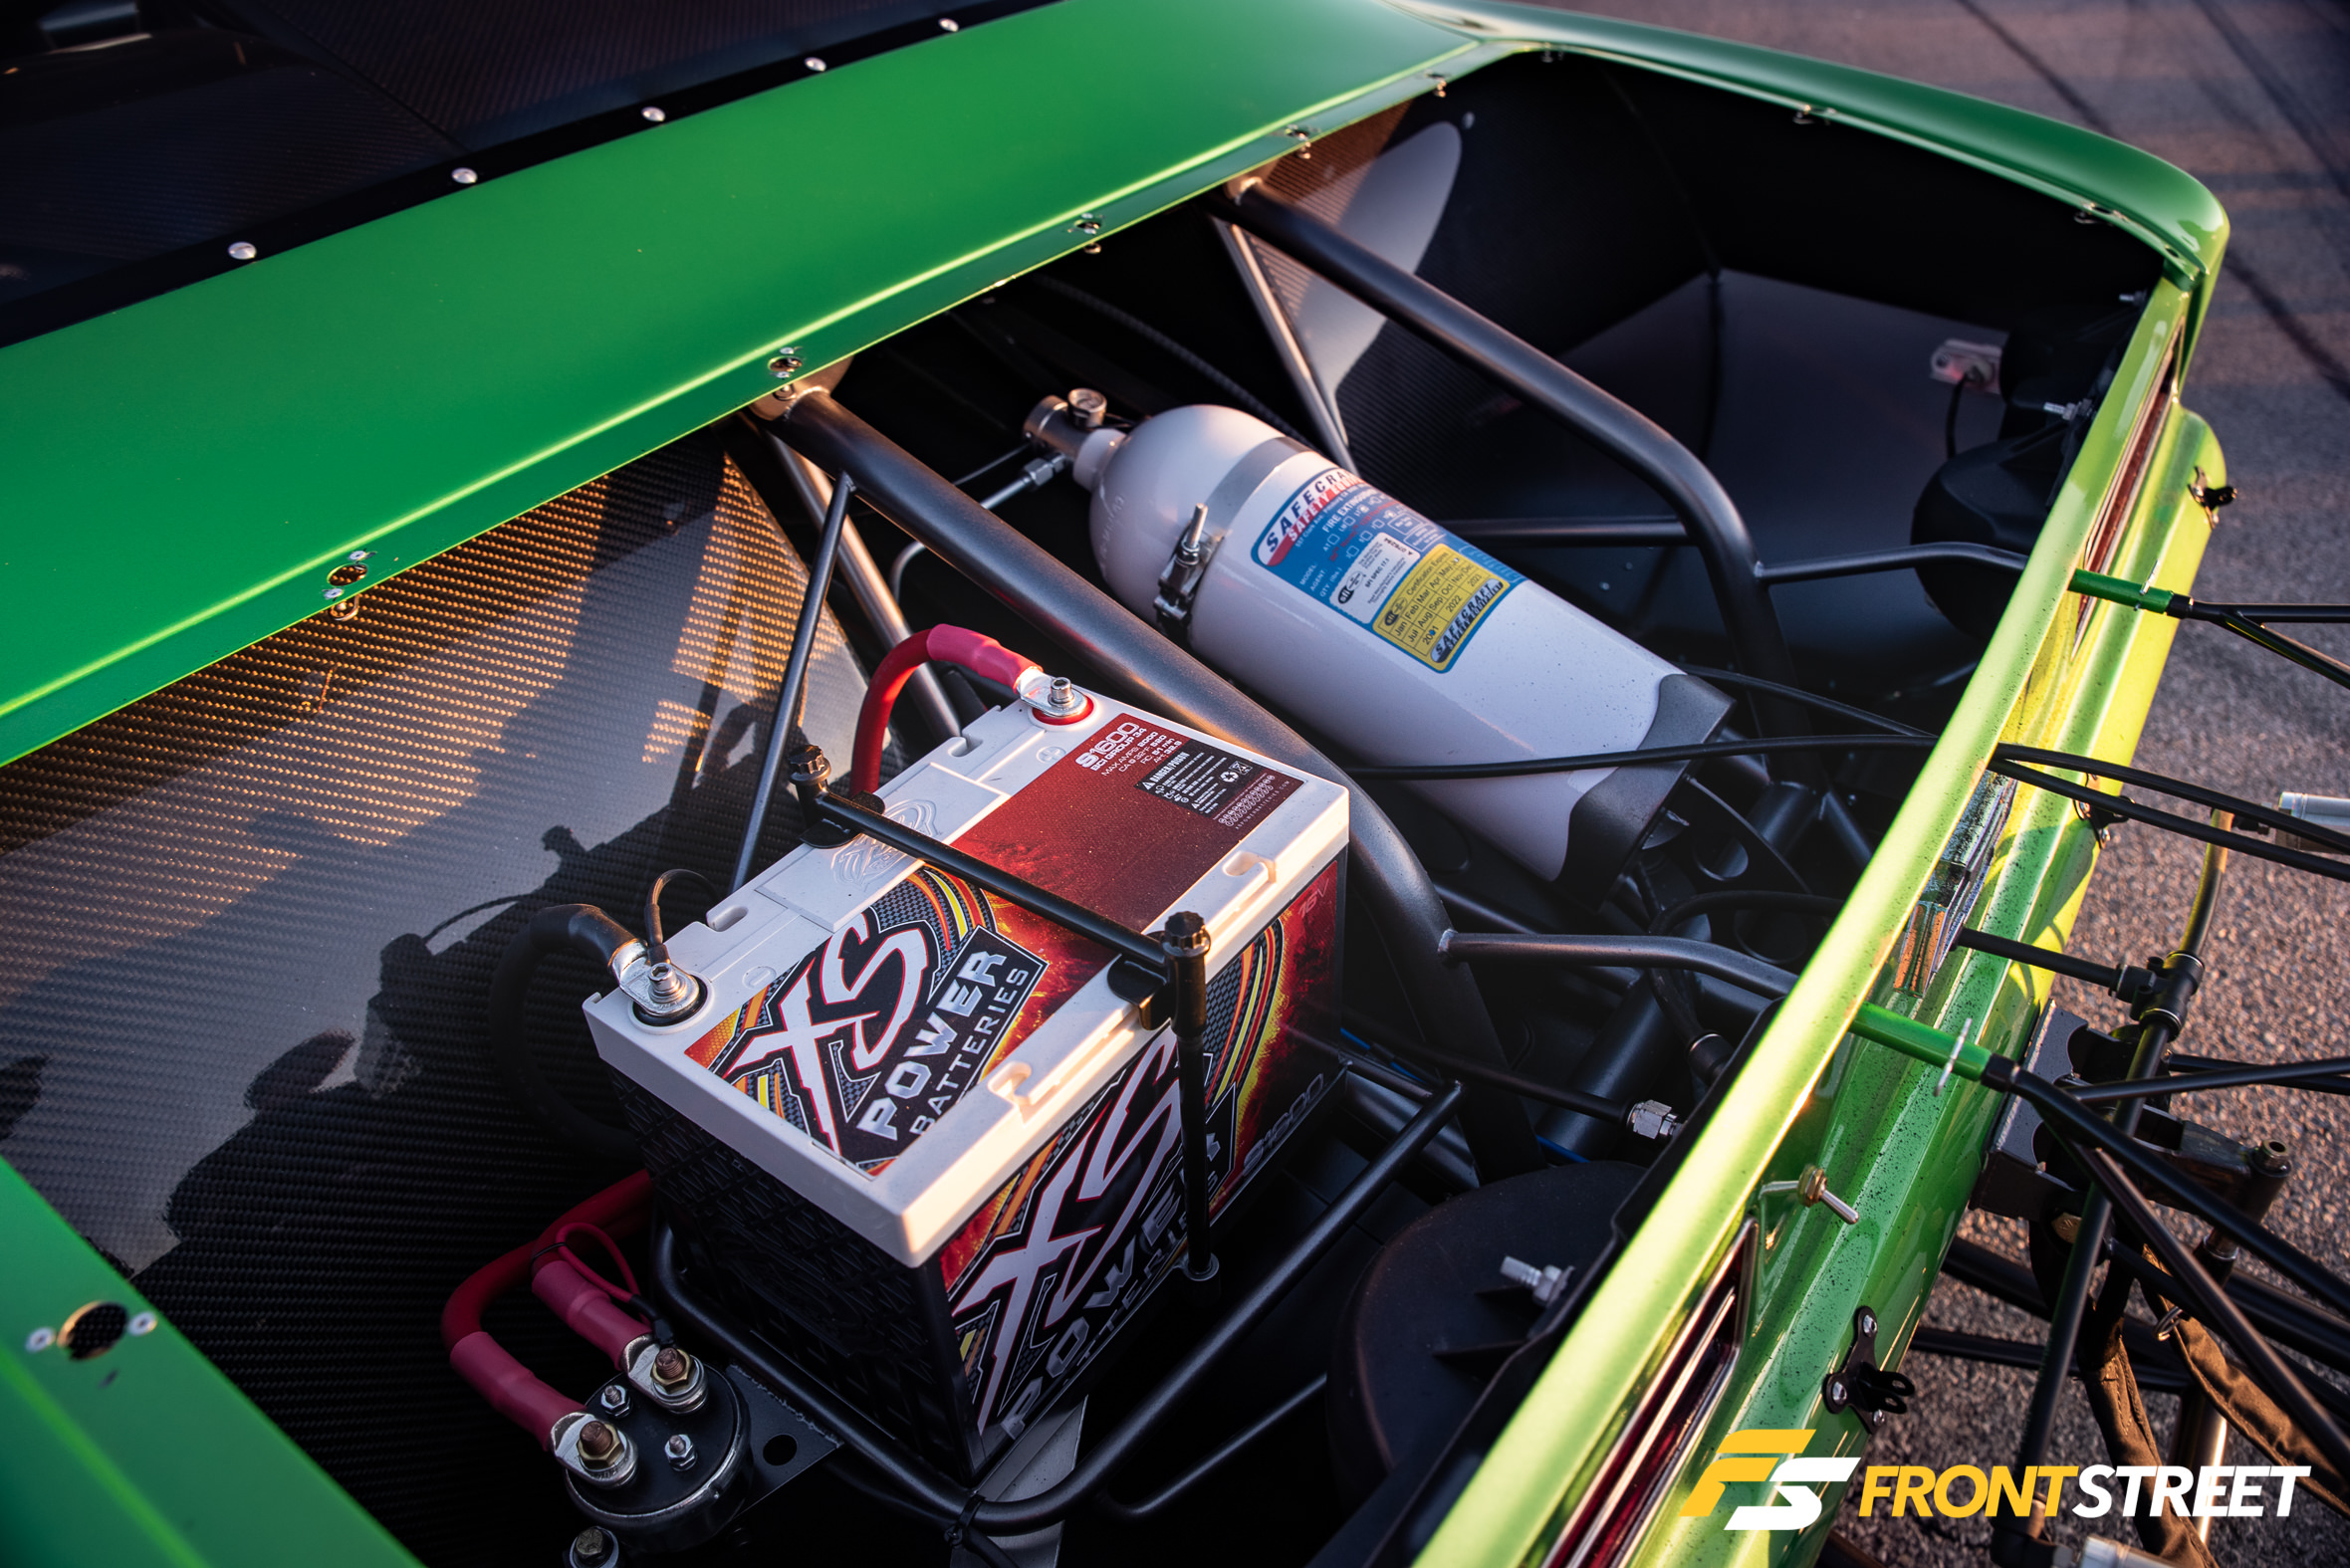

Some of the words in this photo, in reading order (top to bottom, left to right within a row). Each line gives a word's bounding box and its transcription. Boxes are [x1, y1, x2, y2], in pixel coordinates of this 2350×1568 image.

[1288, 488, 1332, 543] SAFETY
[1322, 515, 1340, 533] FIRE
[1394, 621, 1408, 636] Jan
[1404, 604, 1420, 620] Feb
[1416, 589, 1431, 603] Mar
[1429, 576, 1442, 589] Apr
[1439, 564, 1454, 576] May
[1406, 565, 1434, 595] Certification
[1408, 630, 1419, 643] Jul
[1418, 611, 1434, 628] Aug
[1429, 597, 1444, 611] Sep
[1441, 583, 1455, 595] Oct
[1451, 571, 1465, 584] Nov
[1422, 625, 1439, 646] 201
[1445, 594, 1463, 613] 2022
[1467, 573, 1483, 587] 2023
[1435, 582, 1493, 656] SAFECRAFT
[1075, 722, 1140, 769] S1600
[1101, 762, 1120, 777] MAX
[1104, 737, 1135, 761] GROUP
[1132, 728, 1147, 738] 34
[1118, 764, 1132, 773] CA
[1297, 877, 1329, 918] 16V
[722, 913, 928, 1156] XS
[857, 950, 1008, 1141] POWER
[910, 967, 1029, 1135] BATTERIES
[952, 1021, 1182, 1436] XS
